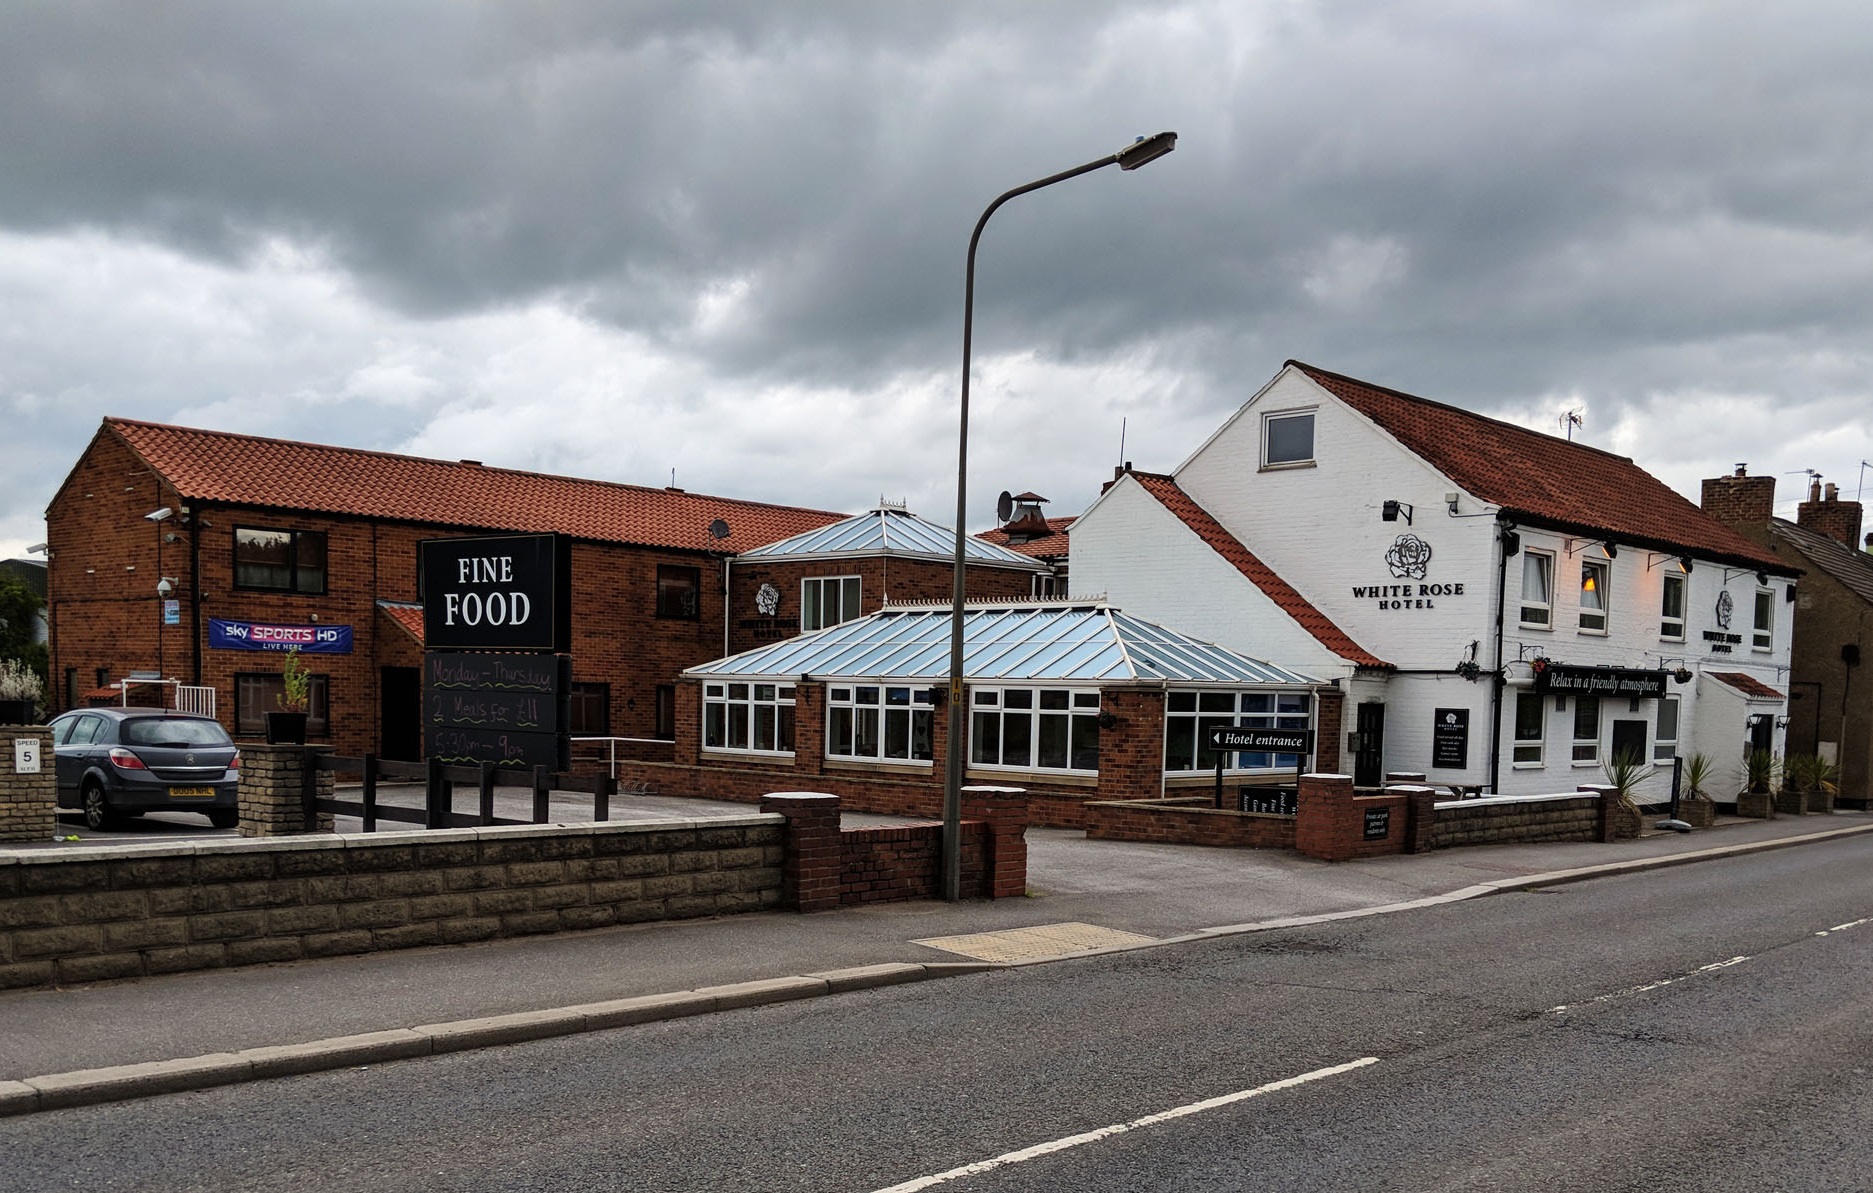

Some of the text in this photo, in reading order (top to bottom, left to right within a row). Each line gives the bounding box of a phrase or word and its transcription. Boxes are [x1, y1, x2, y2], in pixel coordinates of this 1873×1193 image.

[458, 556, 513, 583] FINE
[1352, 583, 1464, 598] WHITE ROSE
[444, 592, 530, 626] FOOD
[1379, 599, 1434, 610] HOTEL
[225, 624, 338, 641] sky SPORTS HD
[432, 659, 479, 690] Monday
[1550, 672, 1659, 695] Relax in a friendly atmosphere
[432, 694, 443, 718] 2
[454, 696, 487, 717] Meals
[1225, 733, 1303, 747] Hotel entrance
[23, 751, 32, 762] 5
